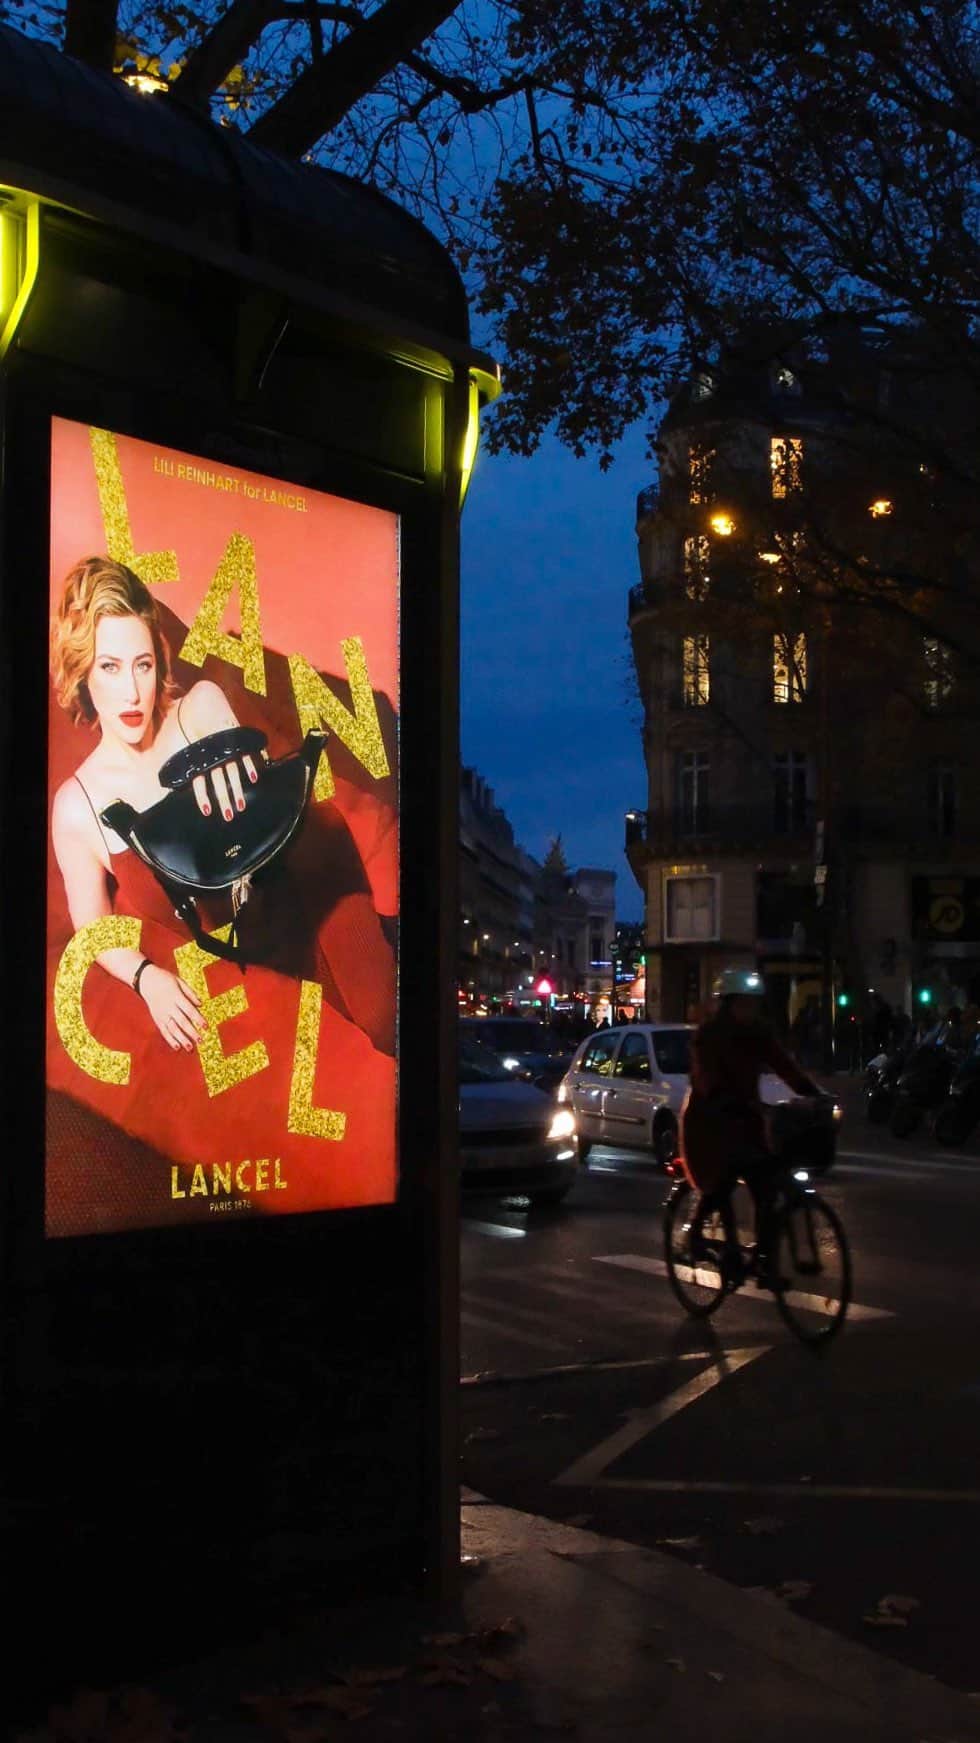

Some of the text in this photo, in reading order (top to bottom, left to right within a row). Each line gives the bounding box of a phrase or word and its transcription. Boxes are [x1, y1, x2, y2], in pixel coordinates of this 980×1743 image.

[153, 456, 308, 512] LILI REINHART for LANCEL
[171, 1158, 288, 1199] LANCEL
[209, 1201, 233, 1212] PARIS
